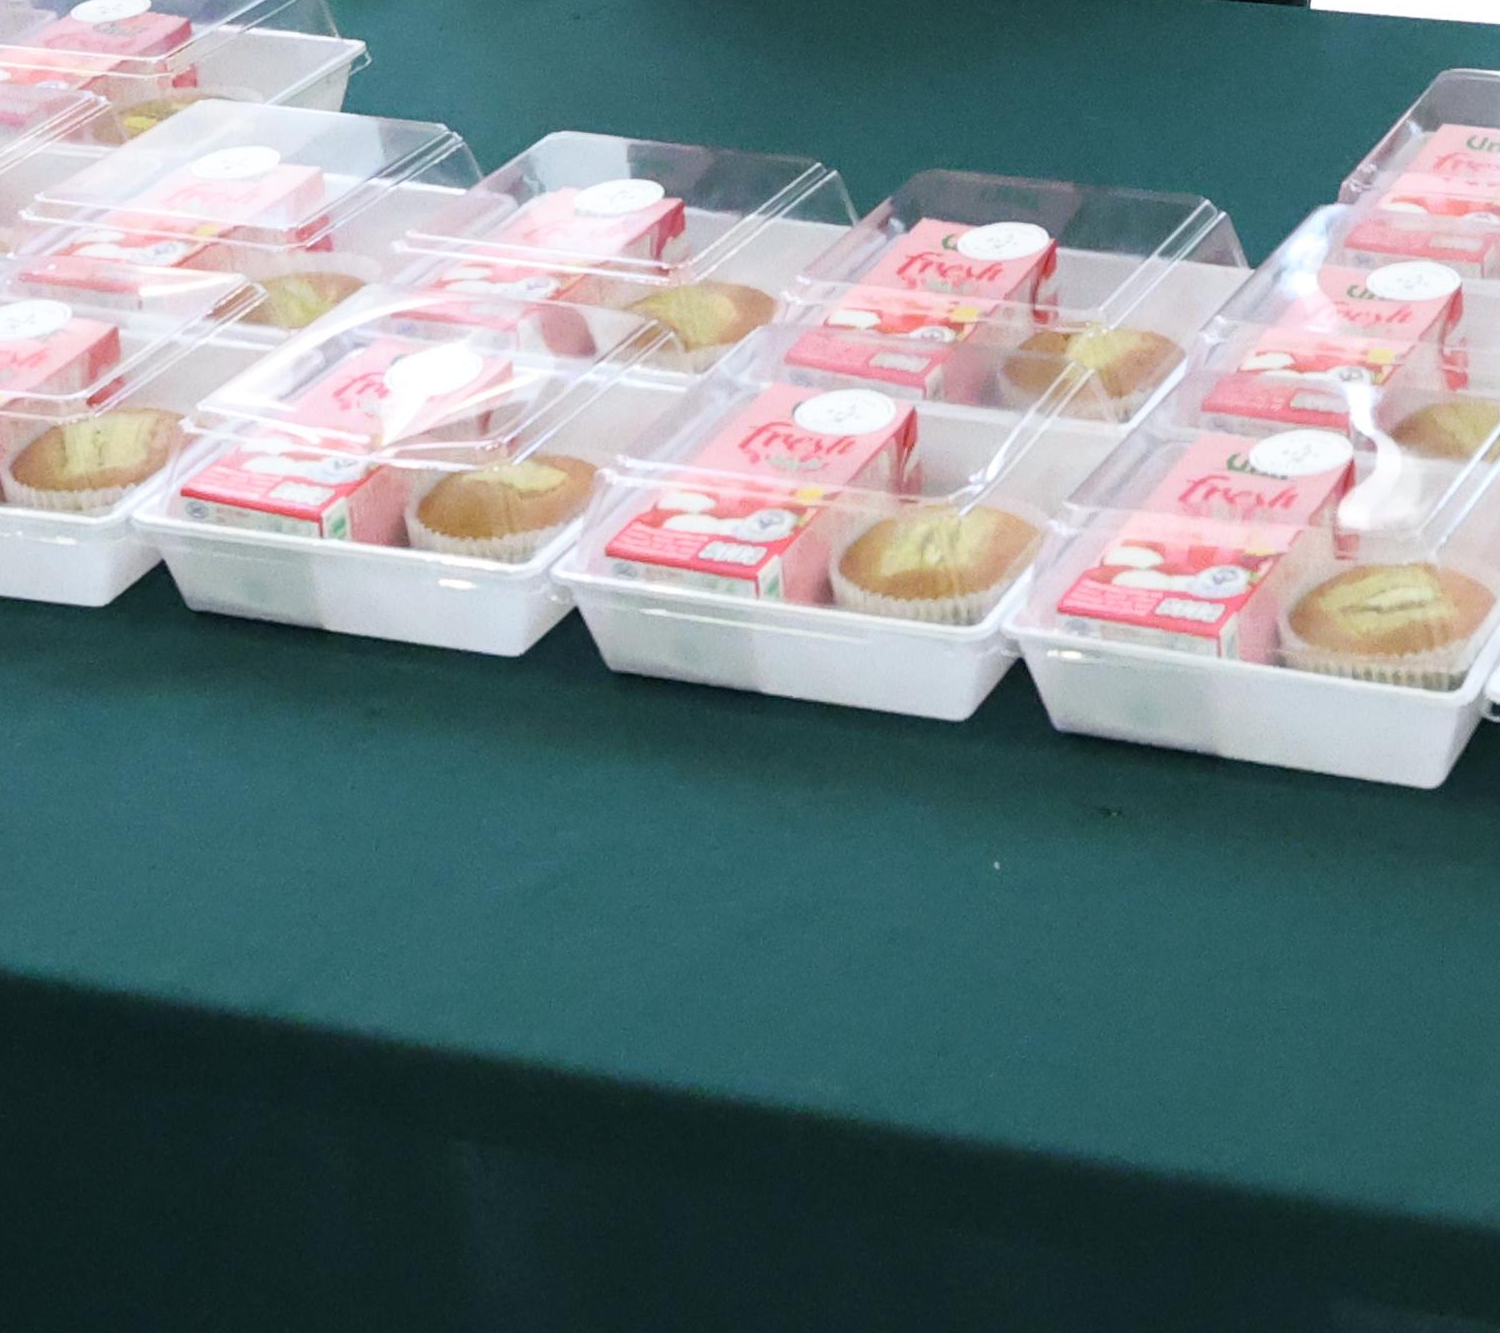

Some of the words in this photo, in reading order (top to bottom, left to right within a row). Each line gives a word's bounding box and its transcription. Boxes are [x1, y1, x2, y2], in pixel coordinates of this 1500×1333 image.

[897, 252, 1003, 283] fresh
[739, 421, 857, 456] fresh
[1178, 475, 1298, 511] fresh
